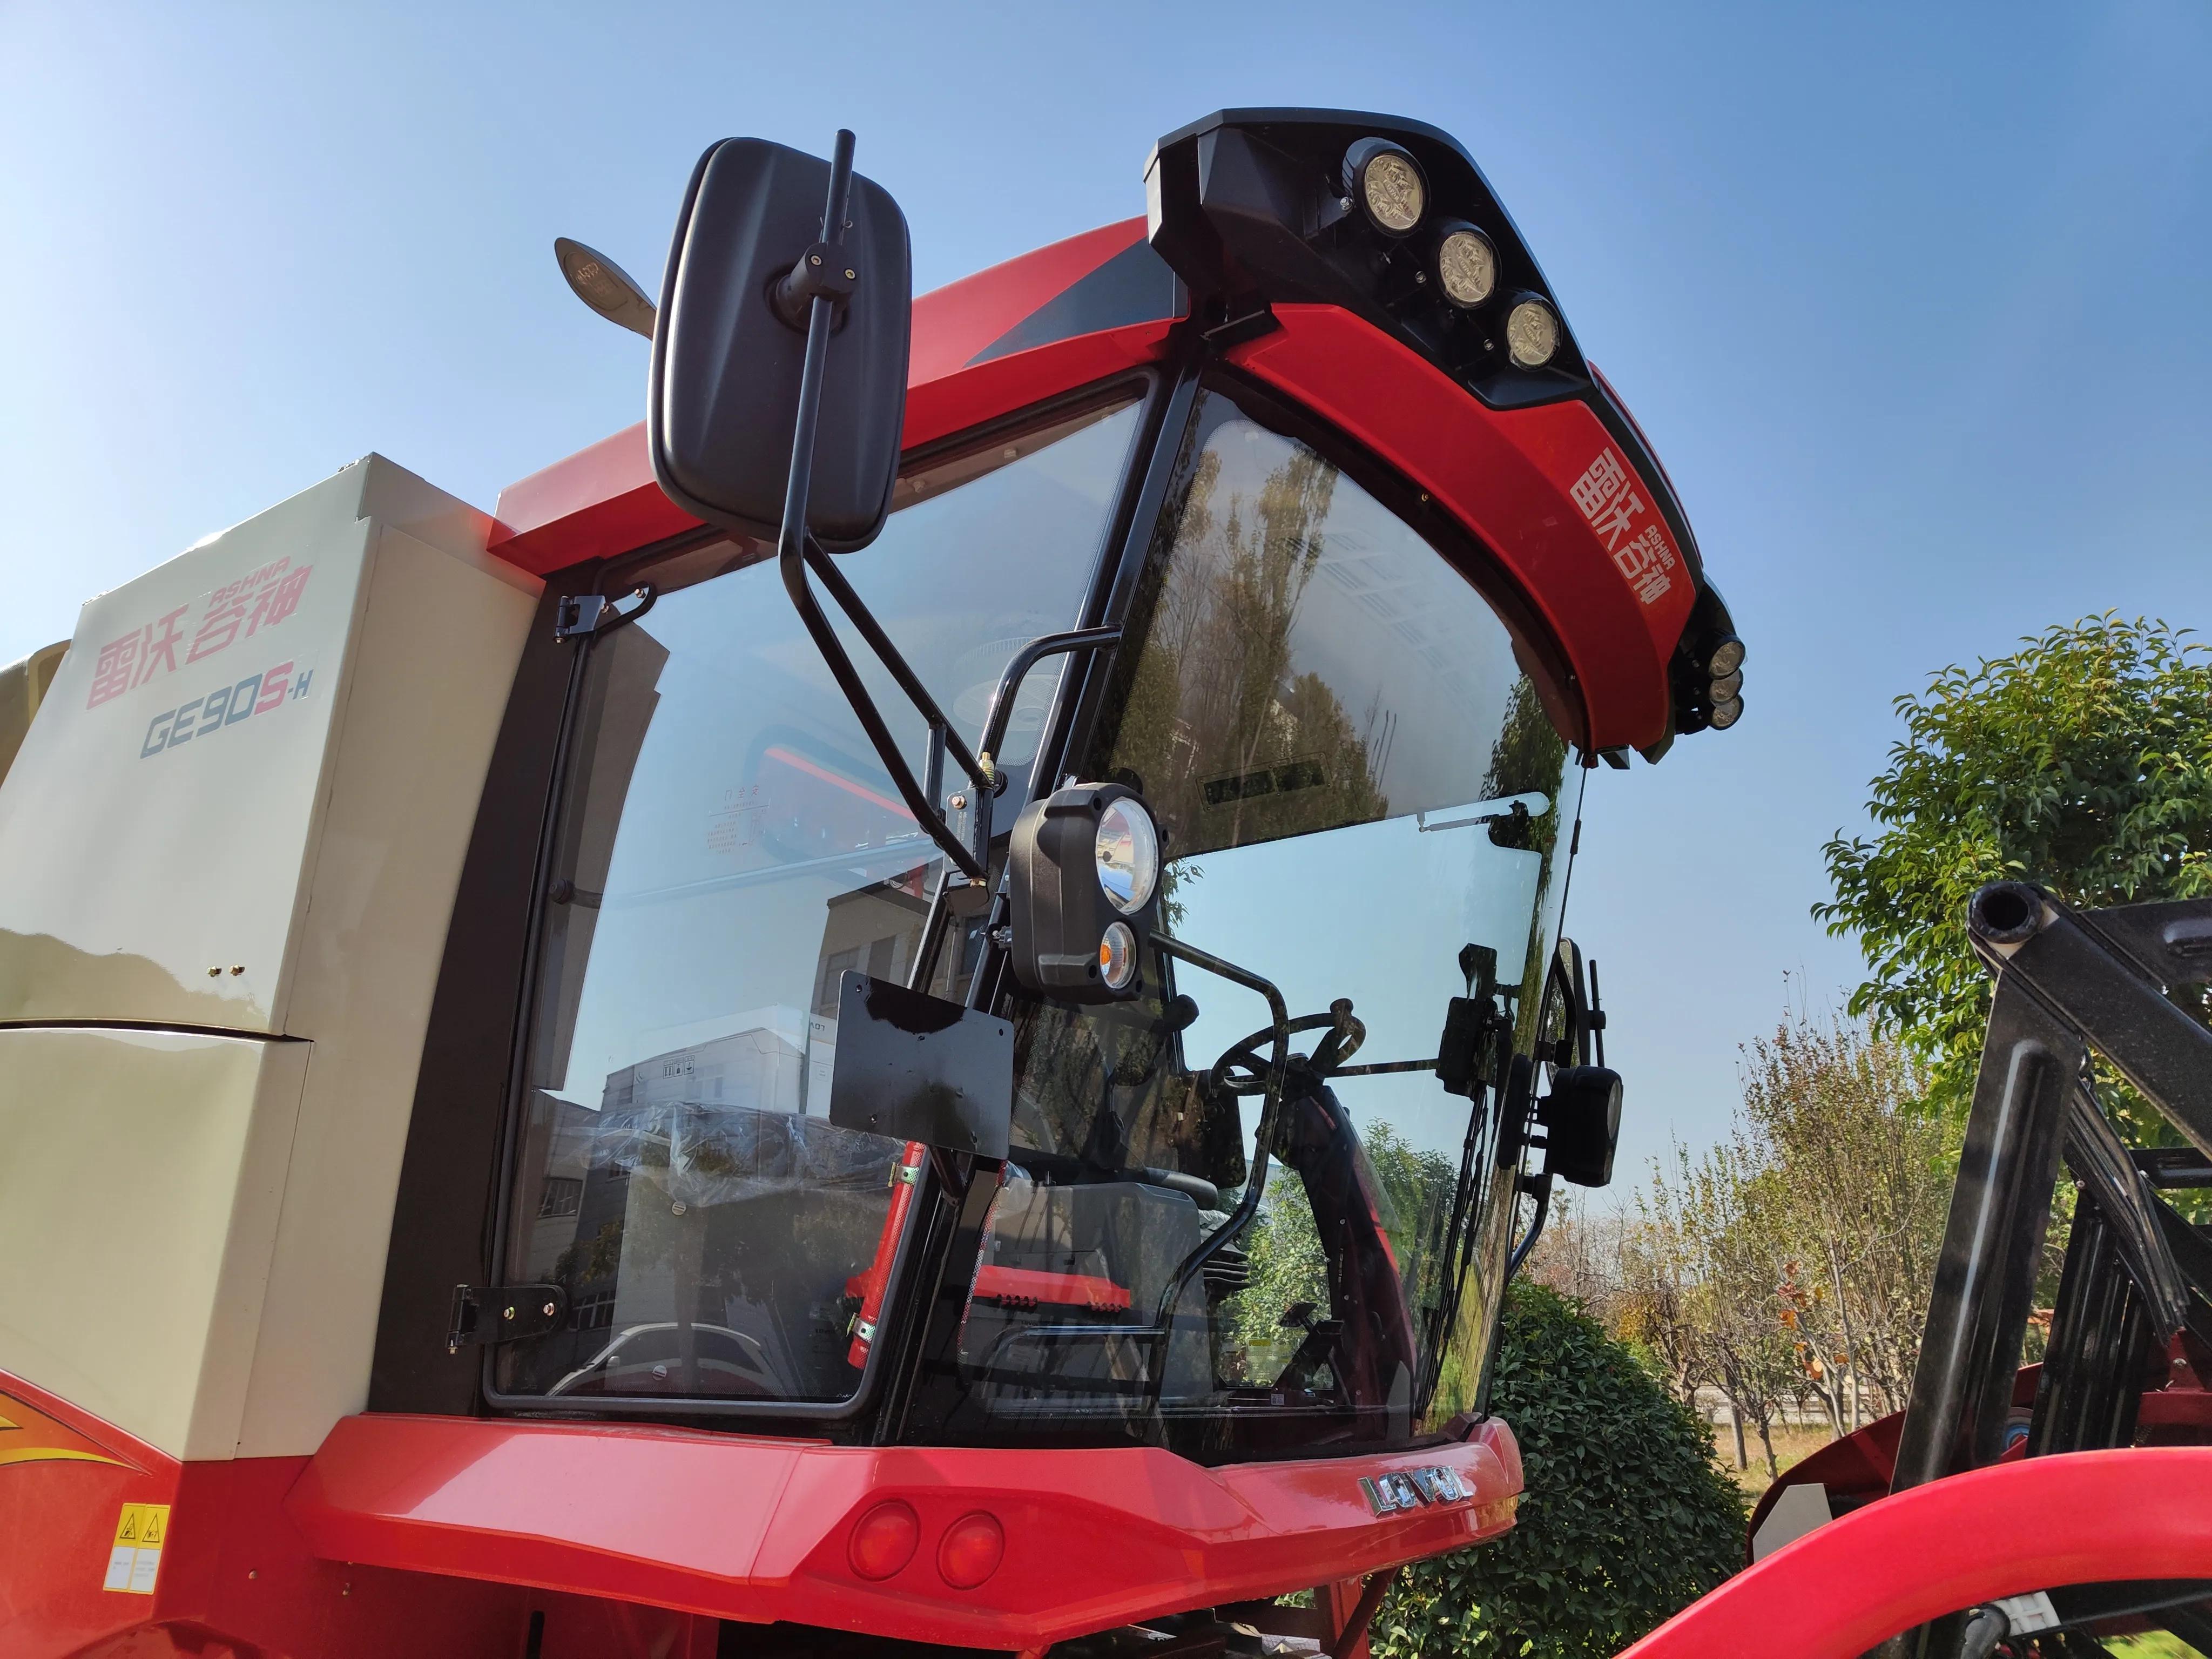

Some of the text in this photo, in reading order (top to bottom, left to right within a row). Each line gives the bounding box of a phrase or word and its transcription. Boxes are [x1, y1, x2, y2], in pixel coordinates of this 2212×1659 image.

[1570, 447, 1672, 605] 雷沃谷神
[1644, 524, 1676, 571] ASHNA
[208, 556, 292, 608] ASHNA
[86, 564, 314, 711] 雷沃谷神
[1357, 1465, 1474, 1518] LOVOL
